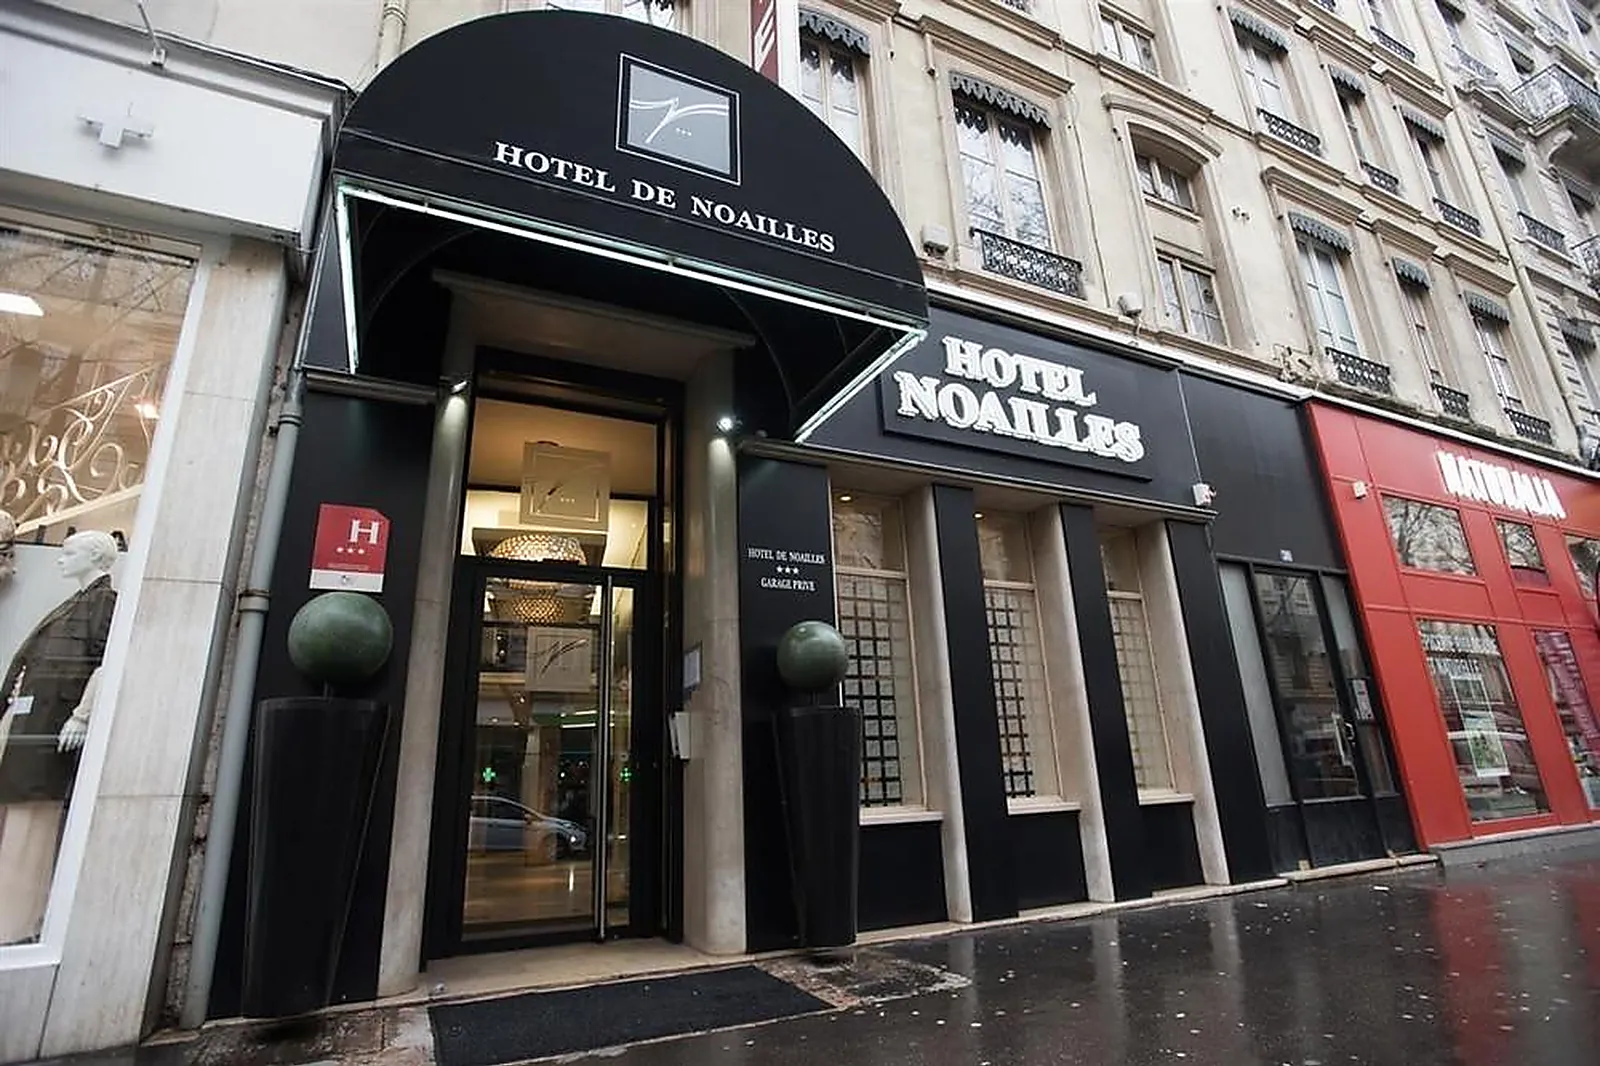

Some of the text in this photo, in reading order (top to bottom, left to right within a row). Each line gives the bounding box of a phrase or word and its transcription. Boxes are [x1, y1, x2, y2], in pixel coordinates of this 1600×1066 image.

[493, 141, 836, 253] HOTEL DE NOAILLES
[942, 336, 1097, 406] HOTEL
[894, 371, 1145, 462] NOAILLES
[350, 519, 379, 545] H
[748, 548, 825, 564] HOTEL DE NOAILLES
